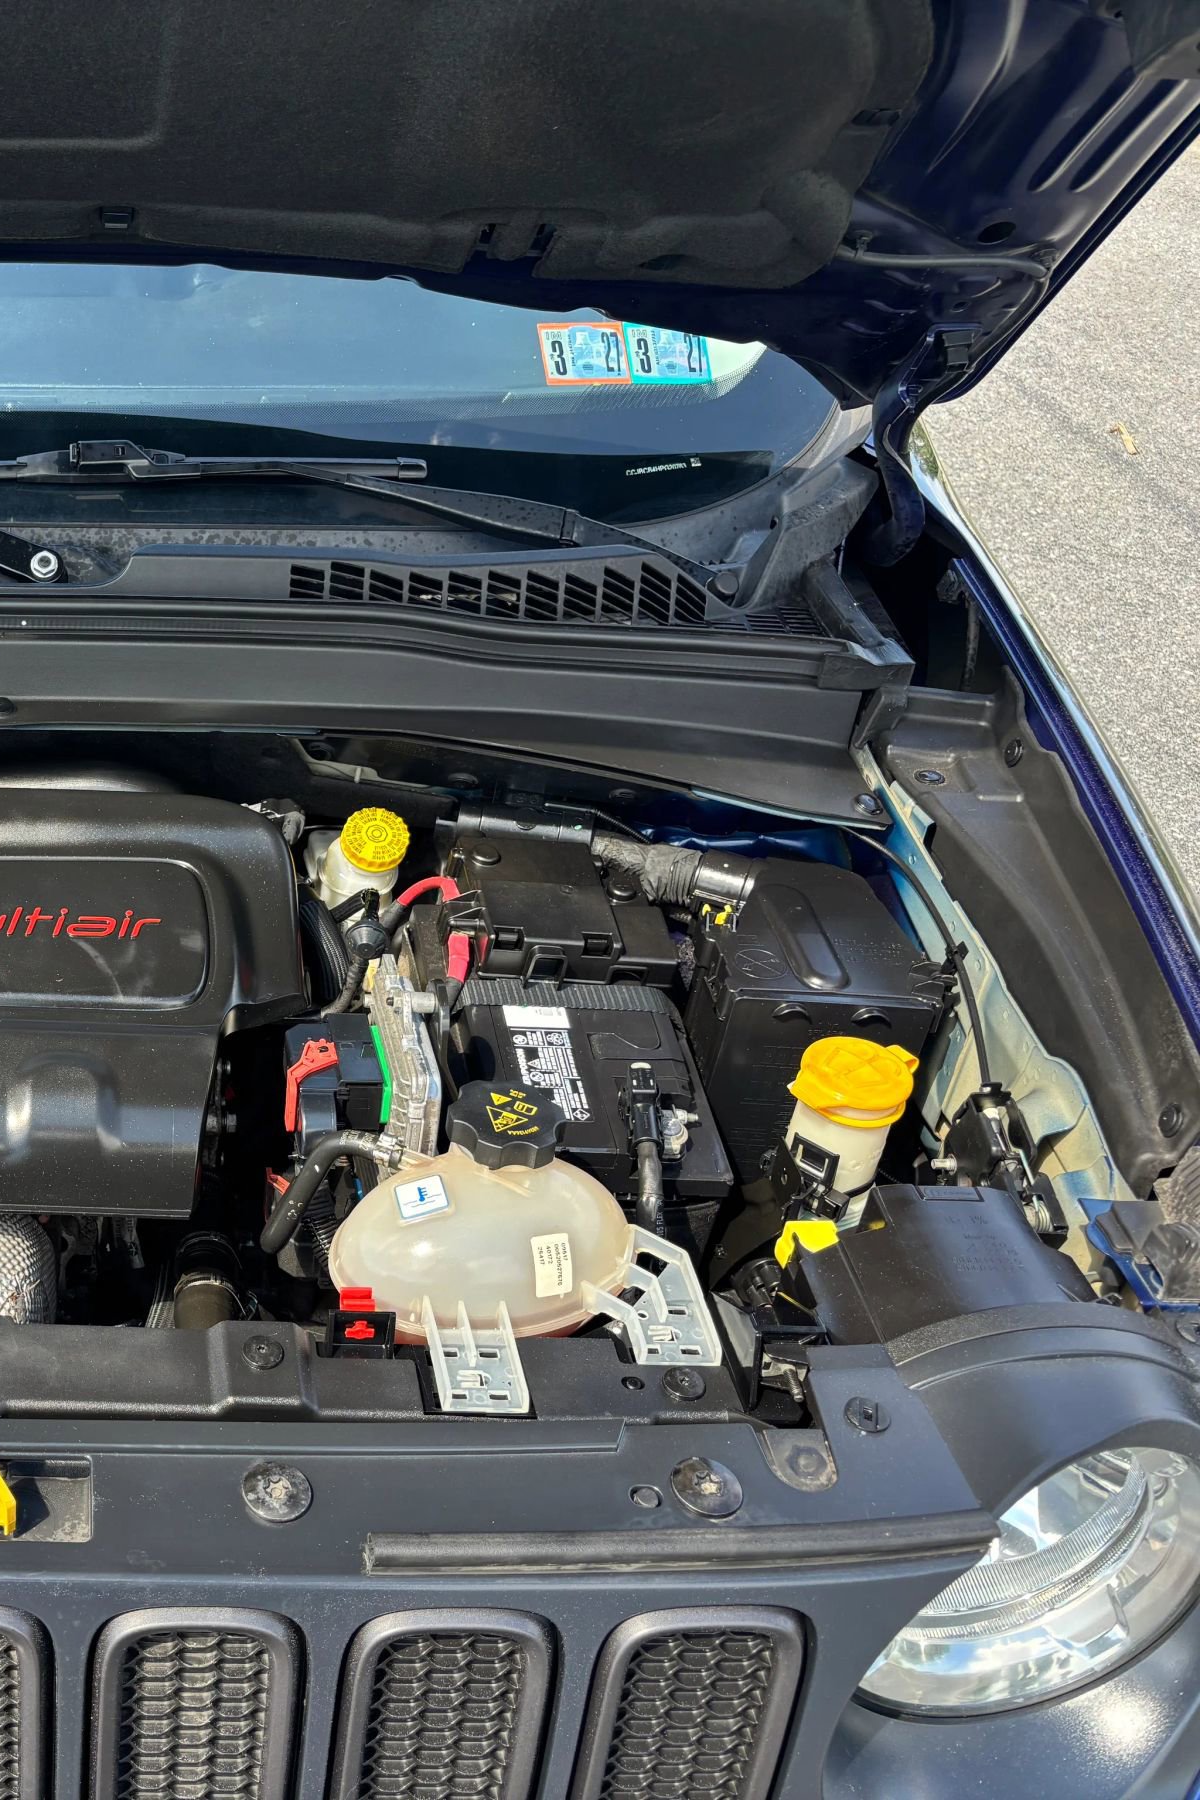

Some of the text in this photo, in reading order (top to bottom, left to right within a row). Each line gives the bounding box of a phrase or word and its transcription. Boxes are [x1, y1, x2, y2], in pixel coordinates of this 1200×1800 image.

[551, 341, 567, 375] 3
[601, 332, 621, 372] 27
[637, 338, 652, 373] 3
